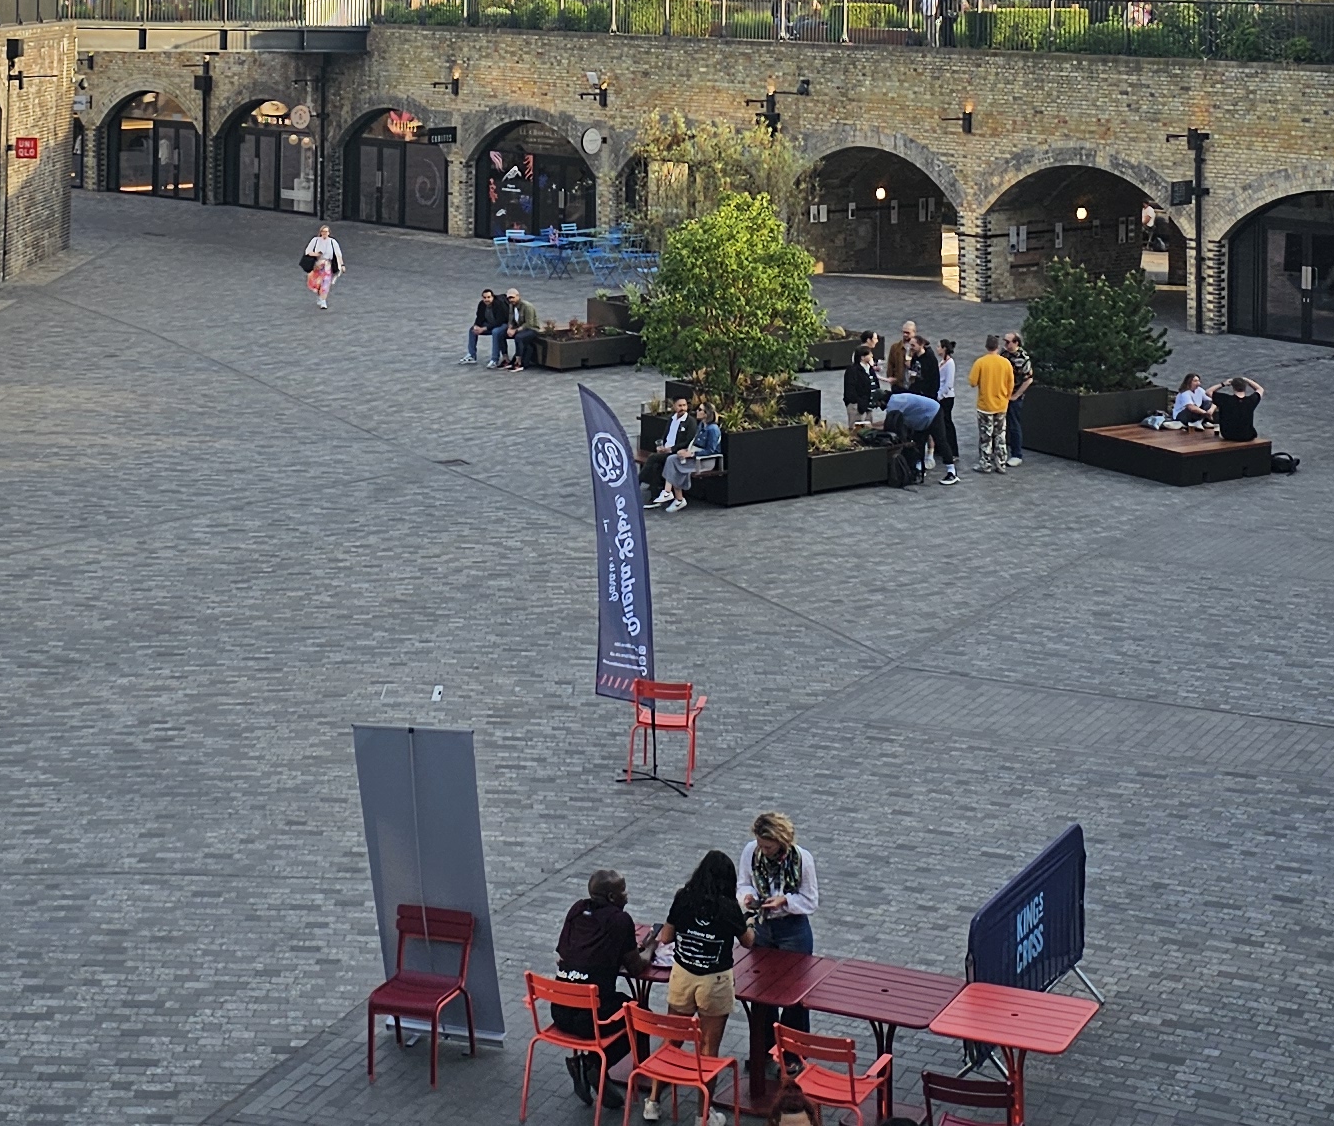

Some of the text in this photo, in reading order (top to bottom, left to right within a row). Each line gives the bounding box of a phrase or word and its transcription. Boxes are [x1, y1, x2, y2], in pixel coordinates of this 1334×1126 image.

[19, 140, 34, 148] UNI
[18, 149, 35, 157] QLO
[1016, 923, 1044, 974] CROSS
